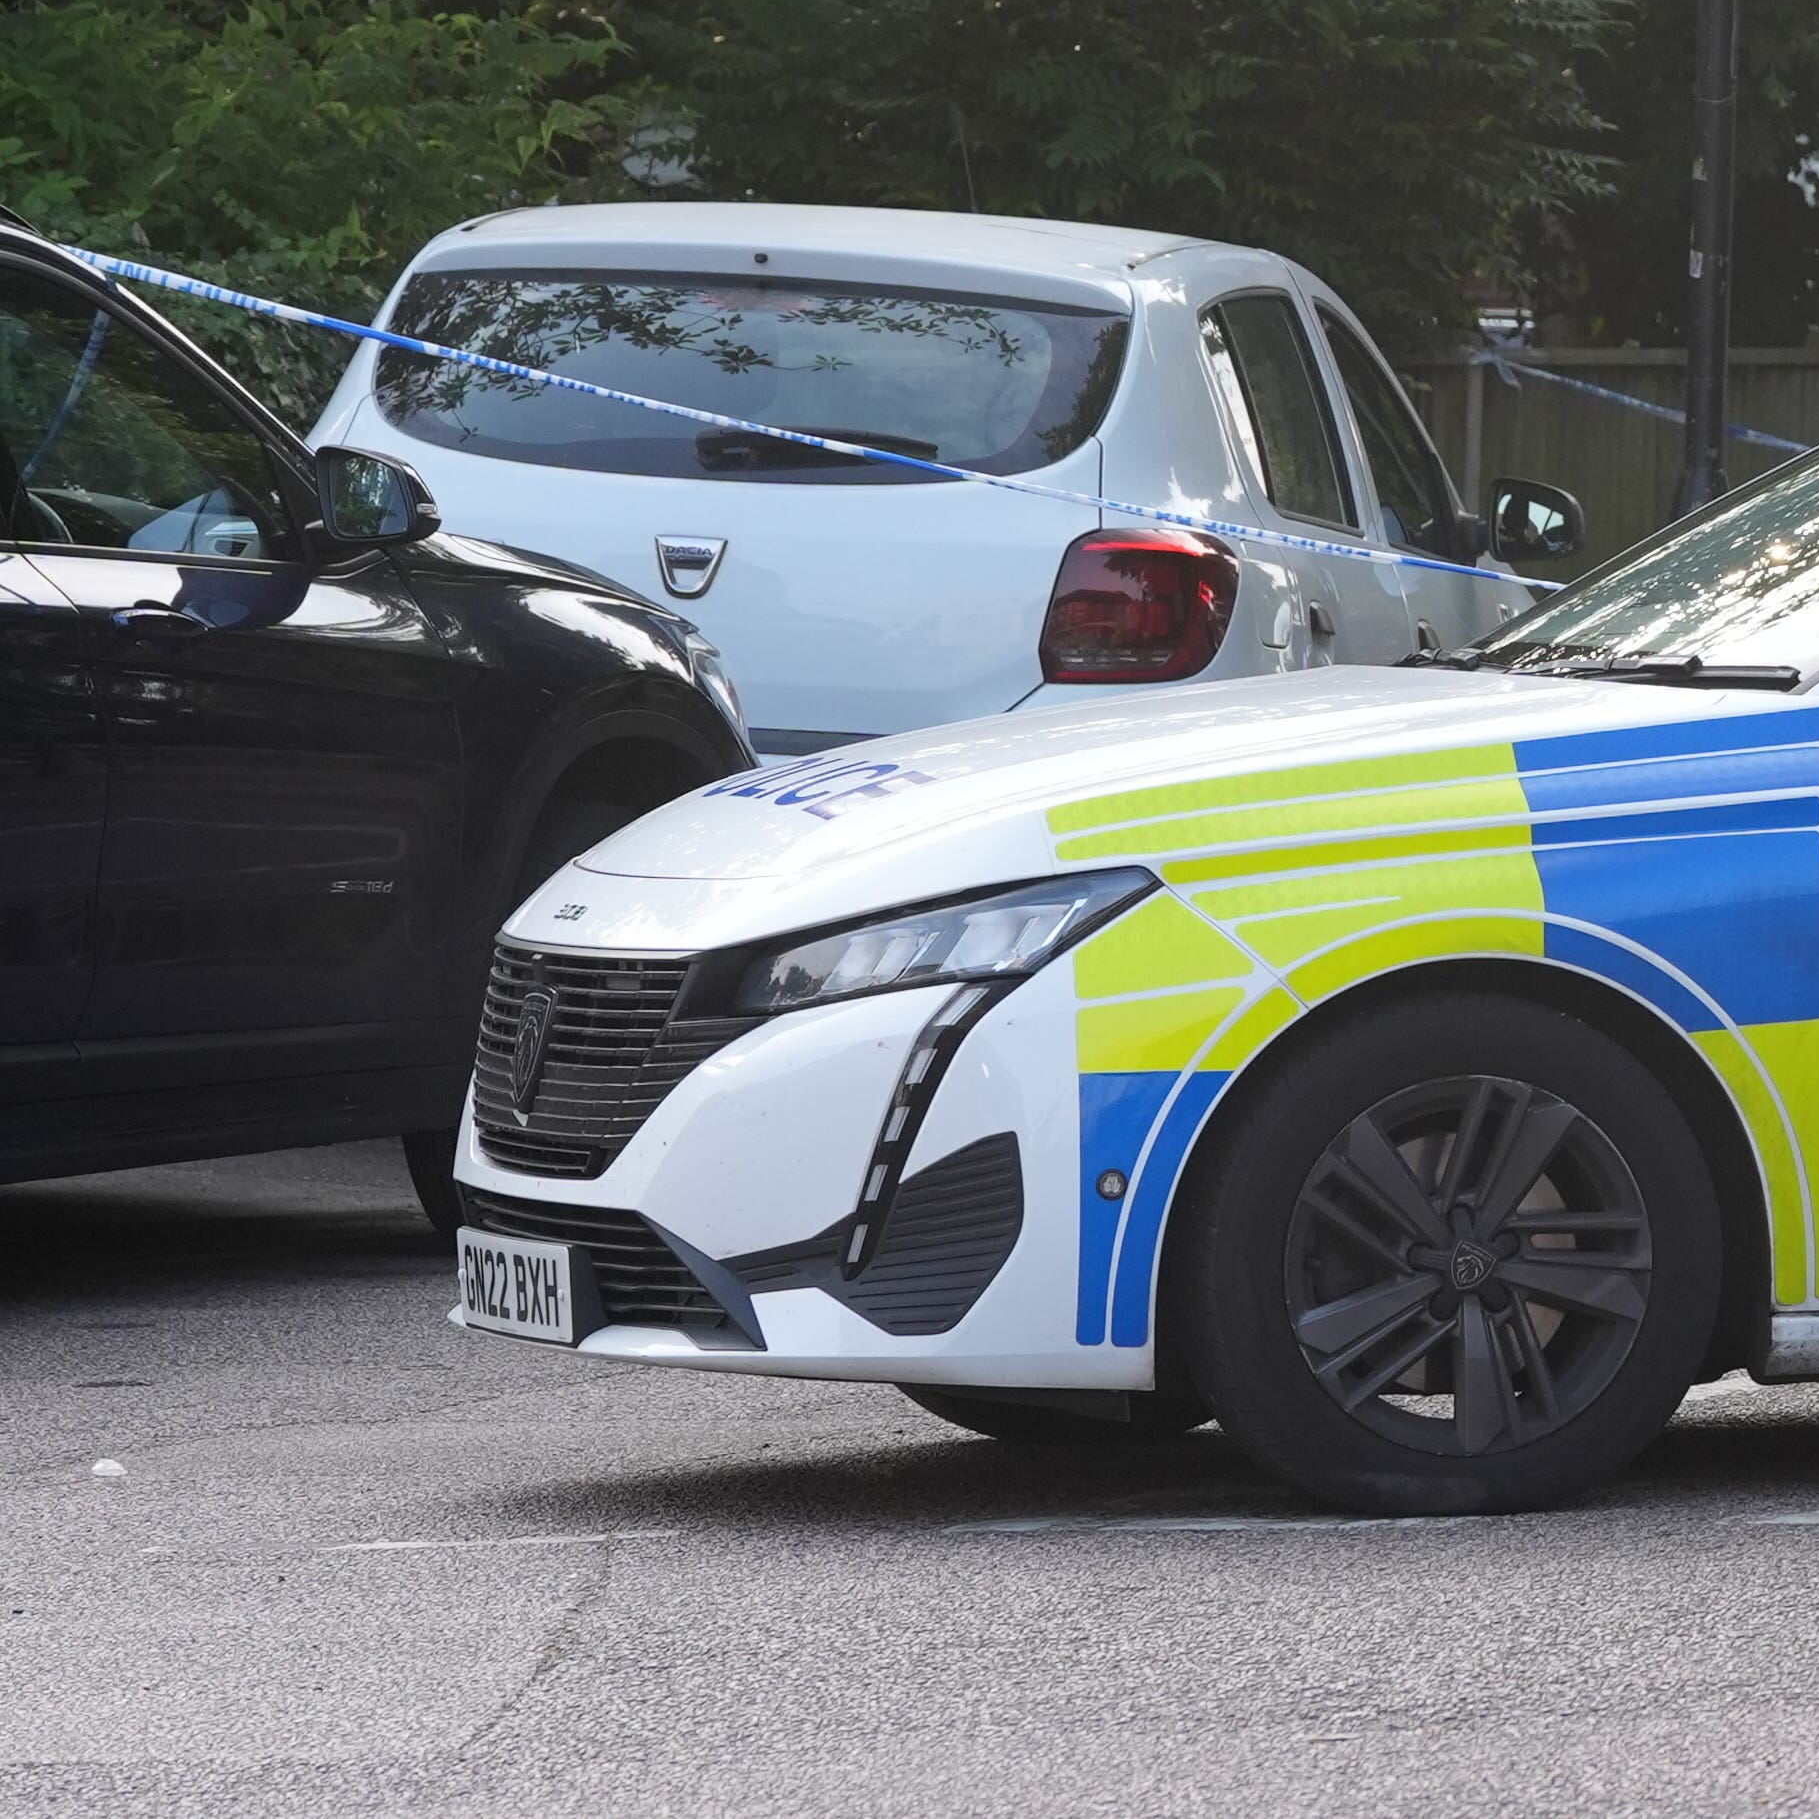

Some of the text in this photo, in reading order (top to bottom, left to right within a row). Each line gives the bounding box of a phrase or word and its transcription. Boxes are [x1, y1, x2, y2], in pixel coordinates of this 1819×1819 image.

[666, 546, 713, 557] DACIA
[702, 757, 937, 820] OLICE
[464, 1244, 559, 1327] GN22 BXH
